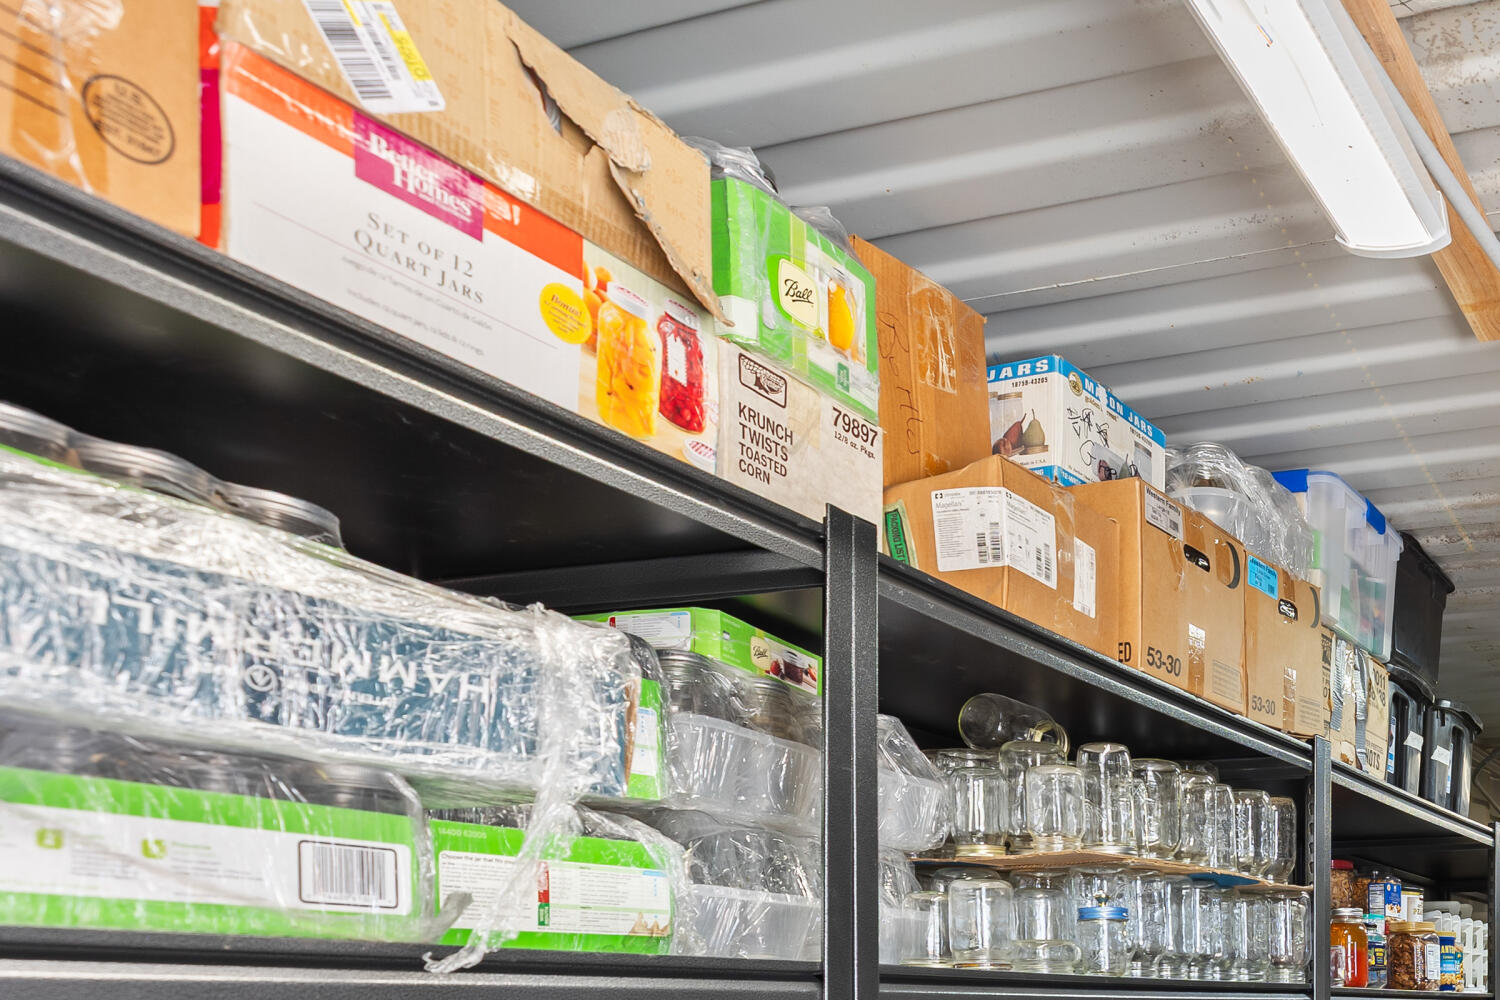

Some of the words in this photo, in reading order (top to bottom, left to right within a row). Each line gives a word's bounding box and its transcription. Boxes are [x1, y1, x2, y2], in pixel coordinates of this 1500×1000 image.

[368, 131, 441, 181] Better
[393, 164, 473, 217] Homes
[453, 254, 474, 278] 12
[784, 278, 814, 304] Ball
[737, 401, 794, 446] KRUNCH
[1084, 377, 1124, 416] MAON
[1127, 411, 1153, 438] JARS
[737, 421, 790, 463] TWISTS
[831, 406, 879, 448] 79897
[738, 441, 788, 478] TOASTED
[738, 459, 771, 486] CORN
[891, 512, 902, 545] PACKING
[1146, 646, 1182, 678] 53-30
[1251, 695, 1276, 717] 53-30
